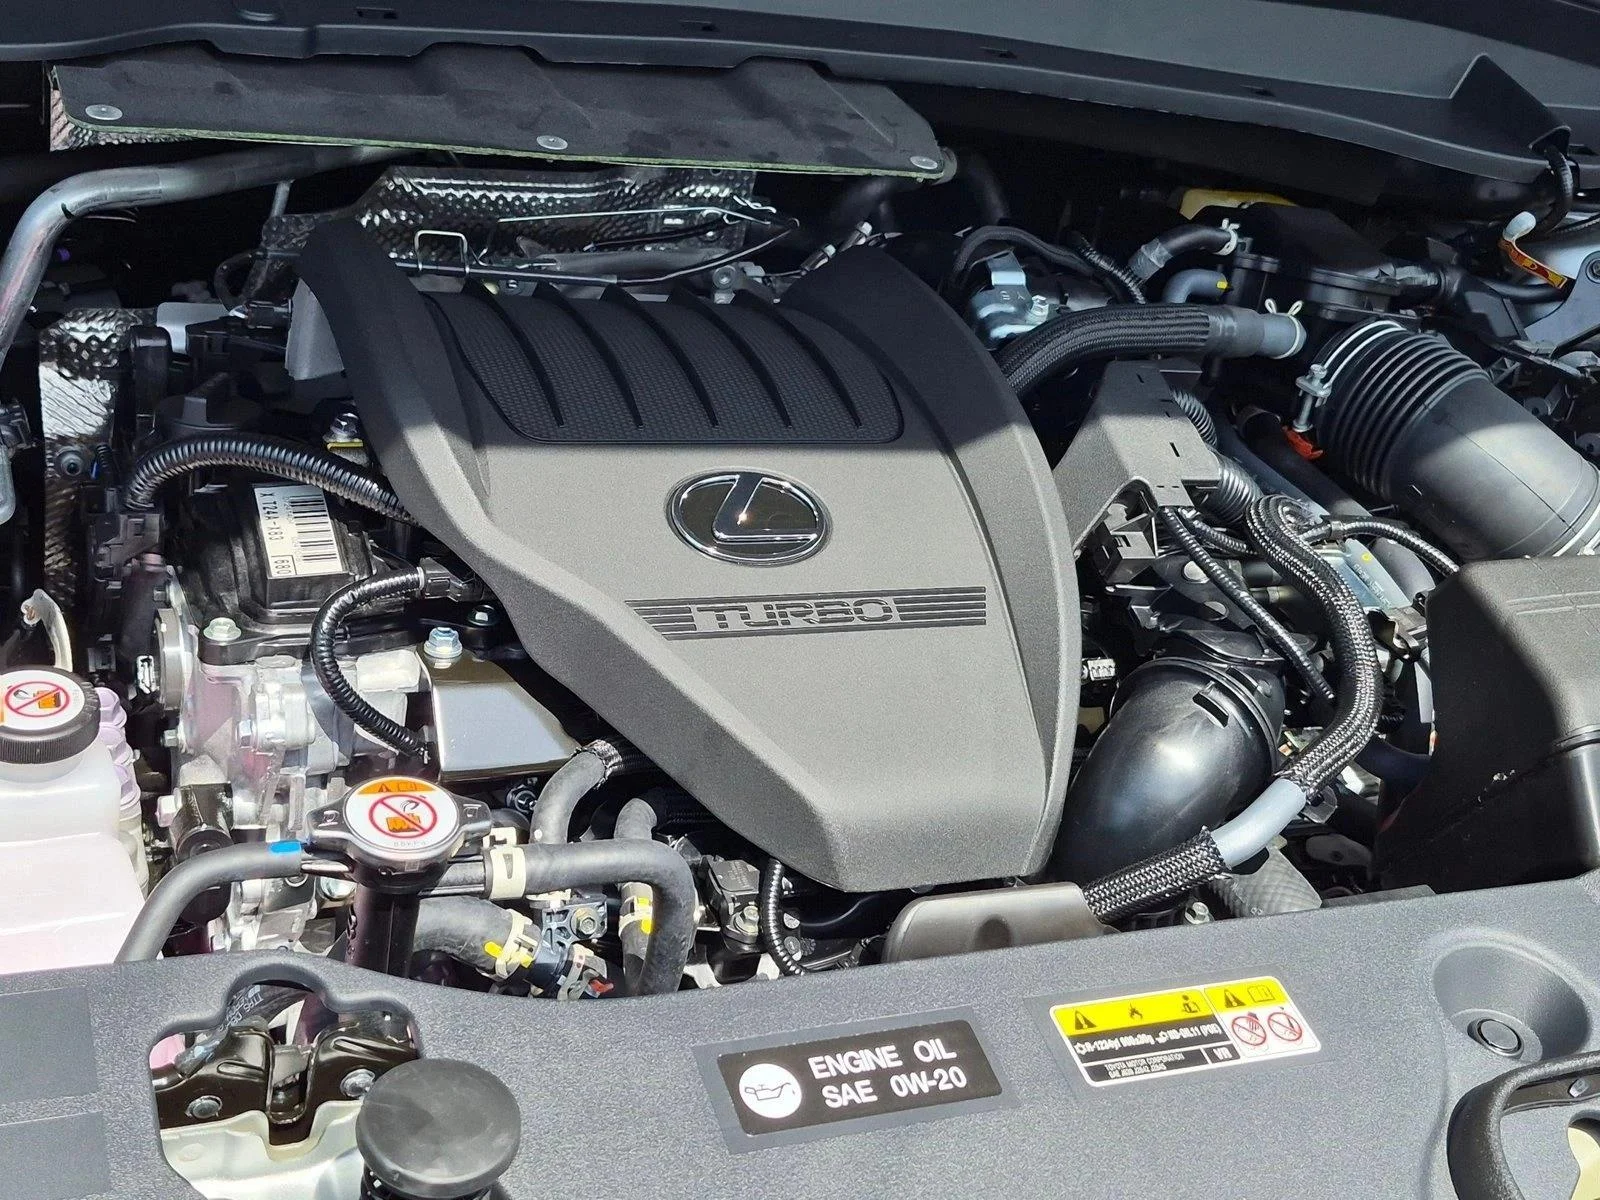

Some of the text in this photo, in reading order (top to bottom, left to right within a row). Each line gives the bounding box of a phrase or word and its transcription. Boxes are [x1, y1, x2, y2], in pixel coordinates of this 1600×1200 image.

[696, 598, 893, 629] TURBO
[807, 1038, 957, 1079] ENGINE OIL
[822, 1066, 967, 1109] SAE 0W-20
